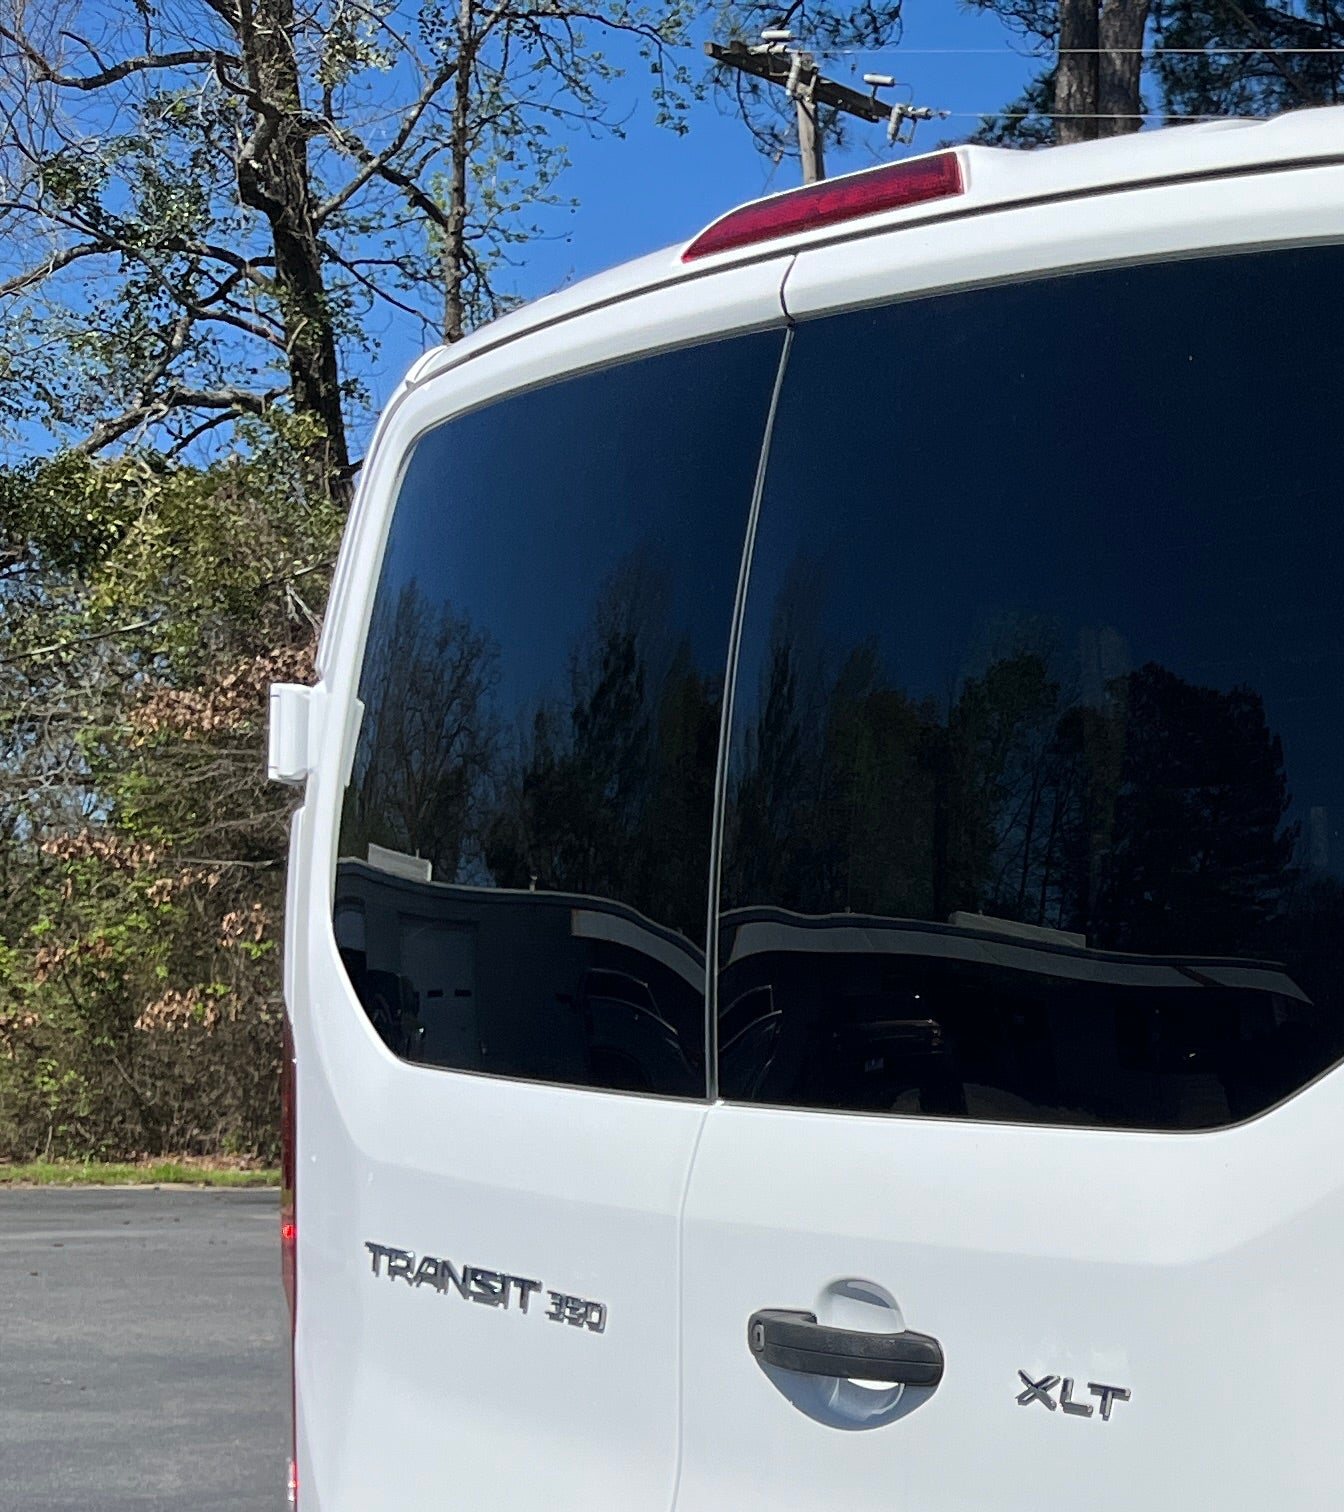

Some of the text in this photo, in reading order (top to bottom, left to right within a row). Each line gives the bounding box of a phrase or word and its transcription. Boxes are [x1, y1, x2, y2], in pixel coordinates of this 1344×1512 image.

[364, 1241, 607, 1334] TRANSIT 350
[1015, 1369, 1131, 1421] XLT
